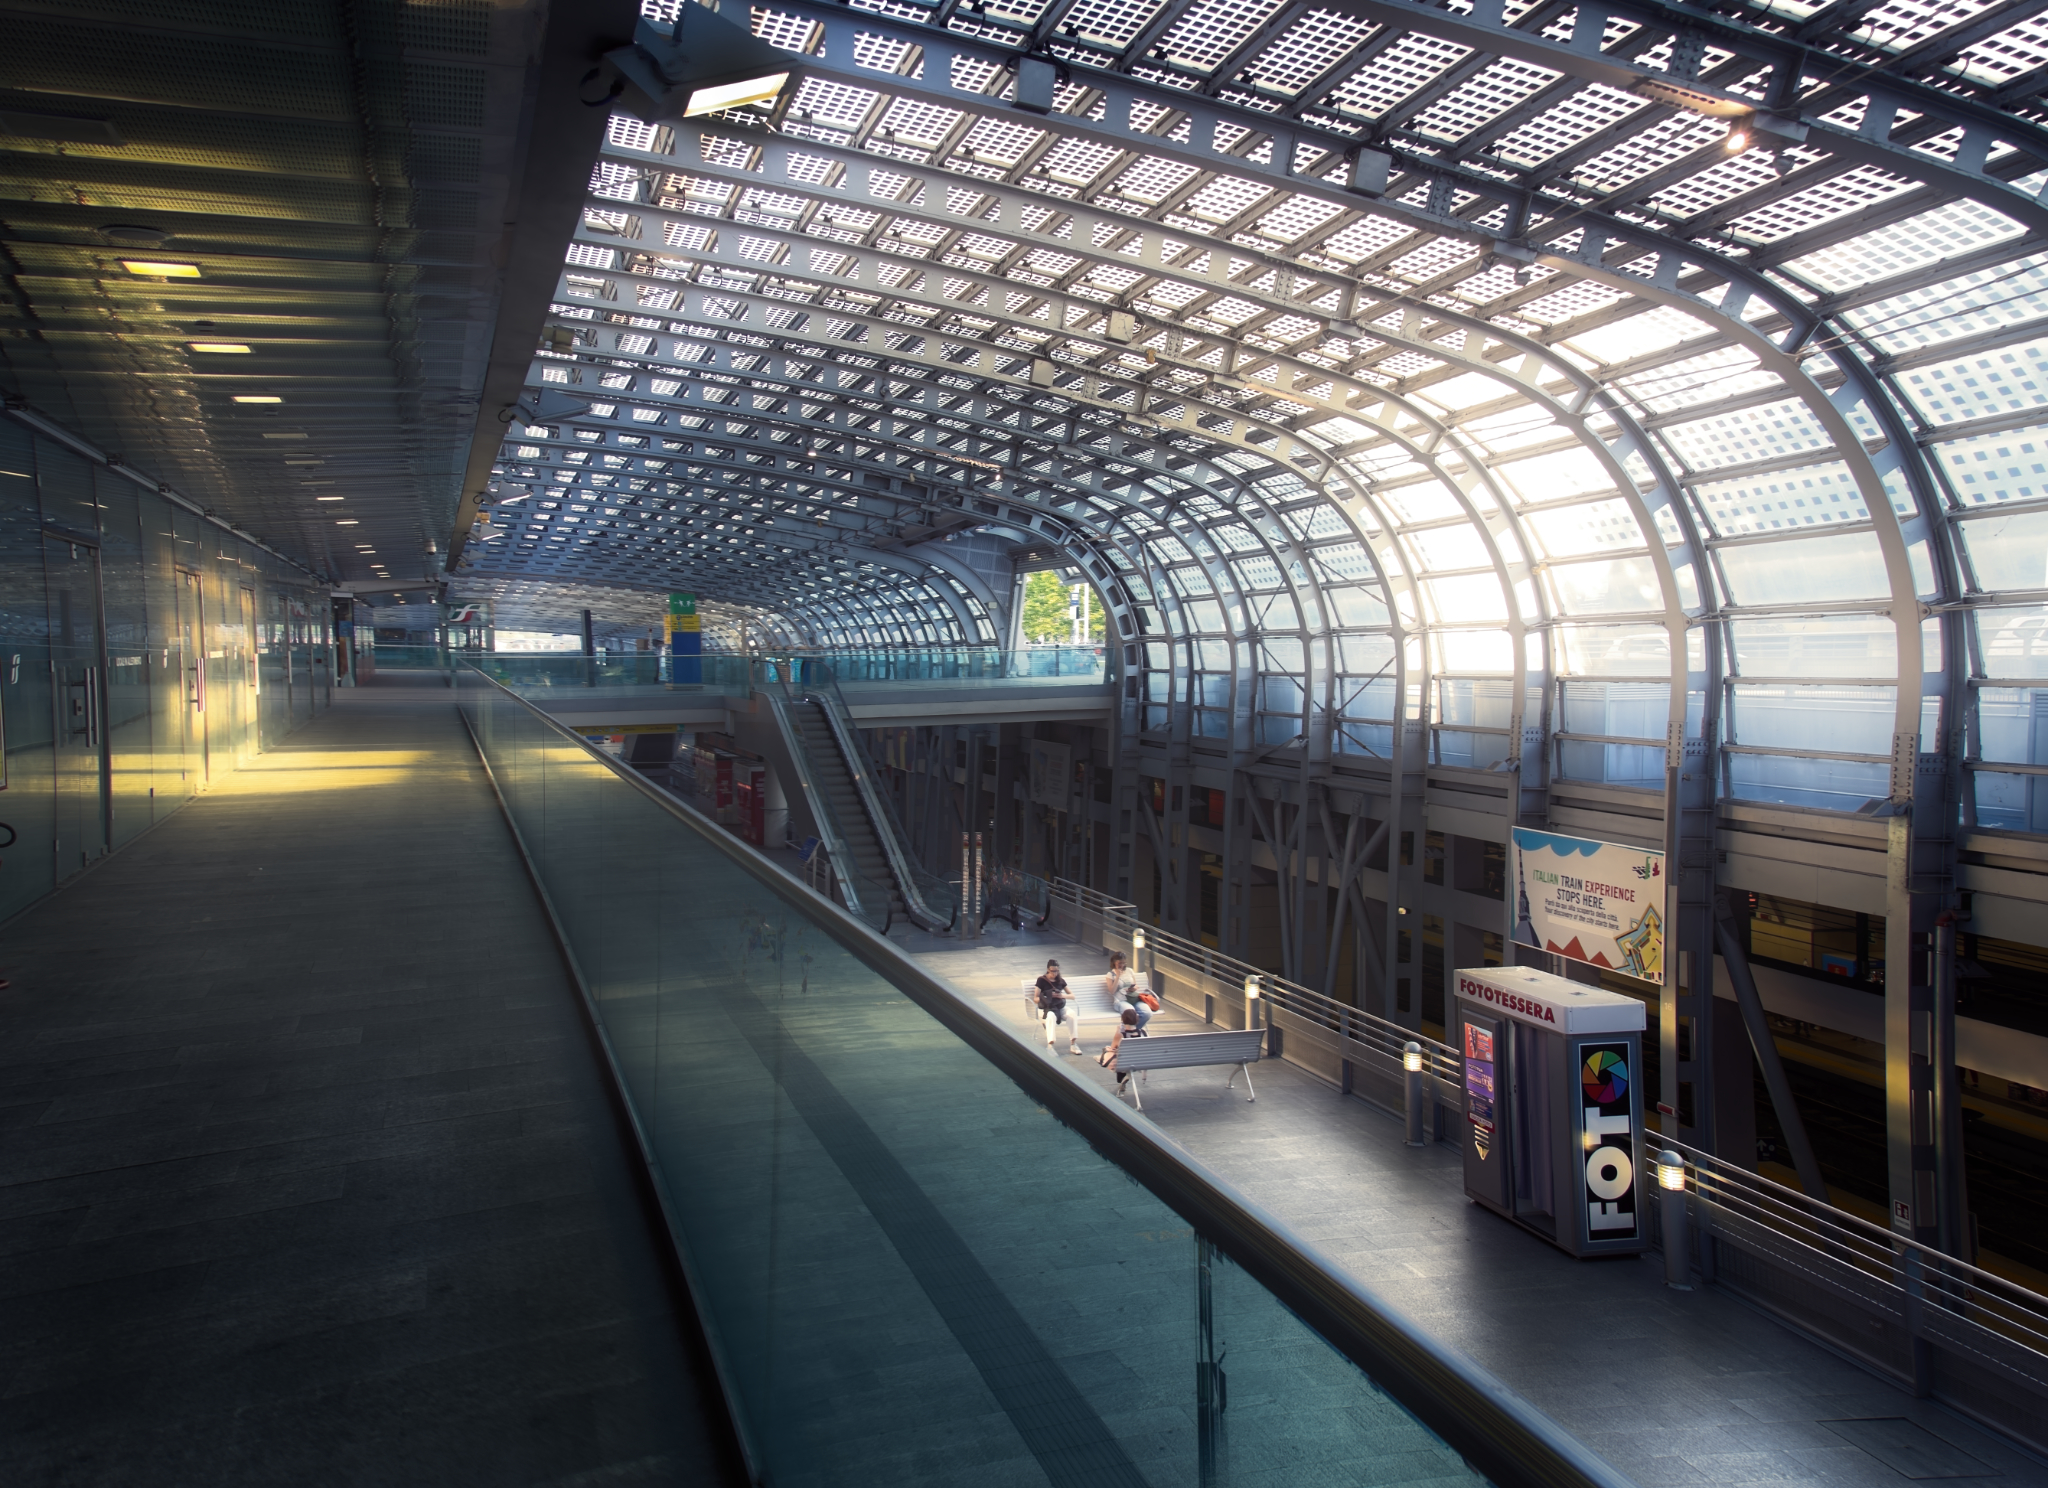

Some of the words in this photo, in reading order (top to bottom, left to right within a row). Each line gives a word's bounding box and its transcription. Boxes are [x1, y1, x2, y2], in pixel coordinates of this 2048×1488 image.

[1533, 869, 1559, 885] ITALIAN
[1561, 875, 1583, 891] TRAIN
[1585, 880, 1635, 902] EXPERIENCE
[1557, 888, 1581, 905] STOPS
[1582, 894, 1606, 911] HERE.
[1460, 978, 1556, 1024] FOTOTESSERA
[1664, 1002, 1673, 1011] 16
